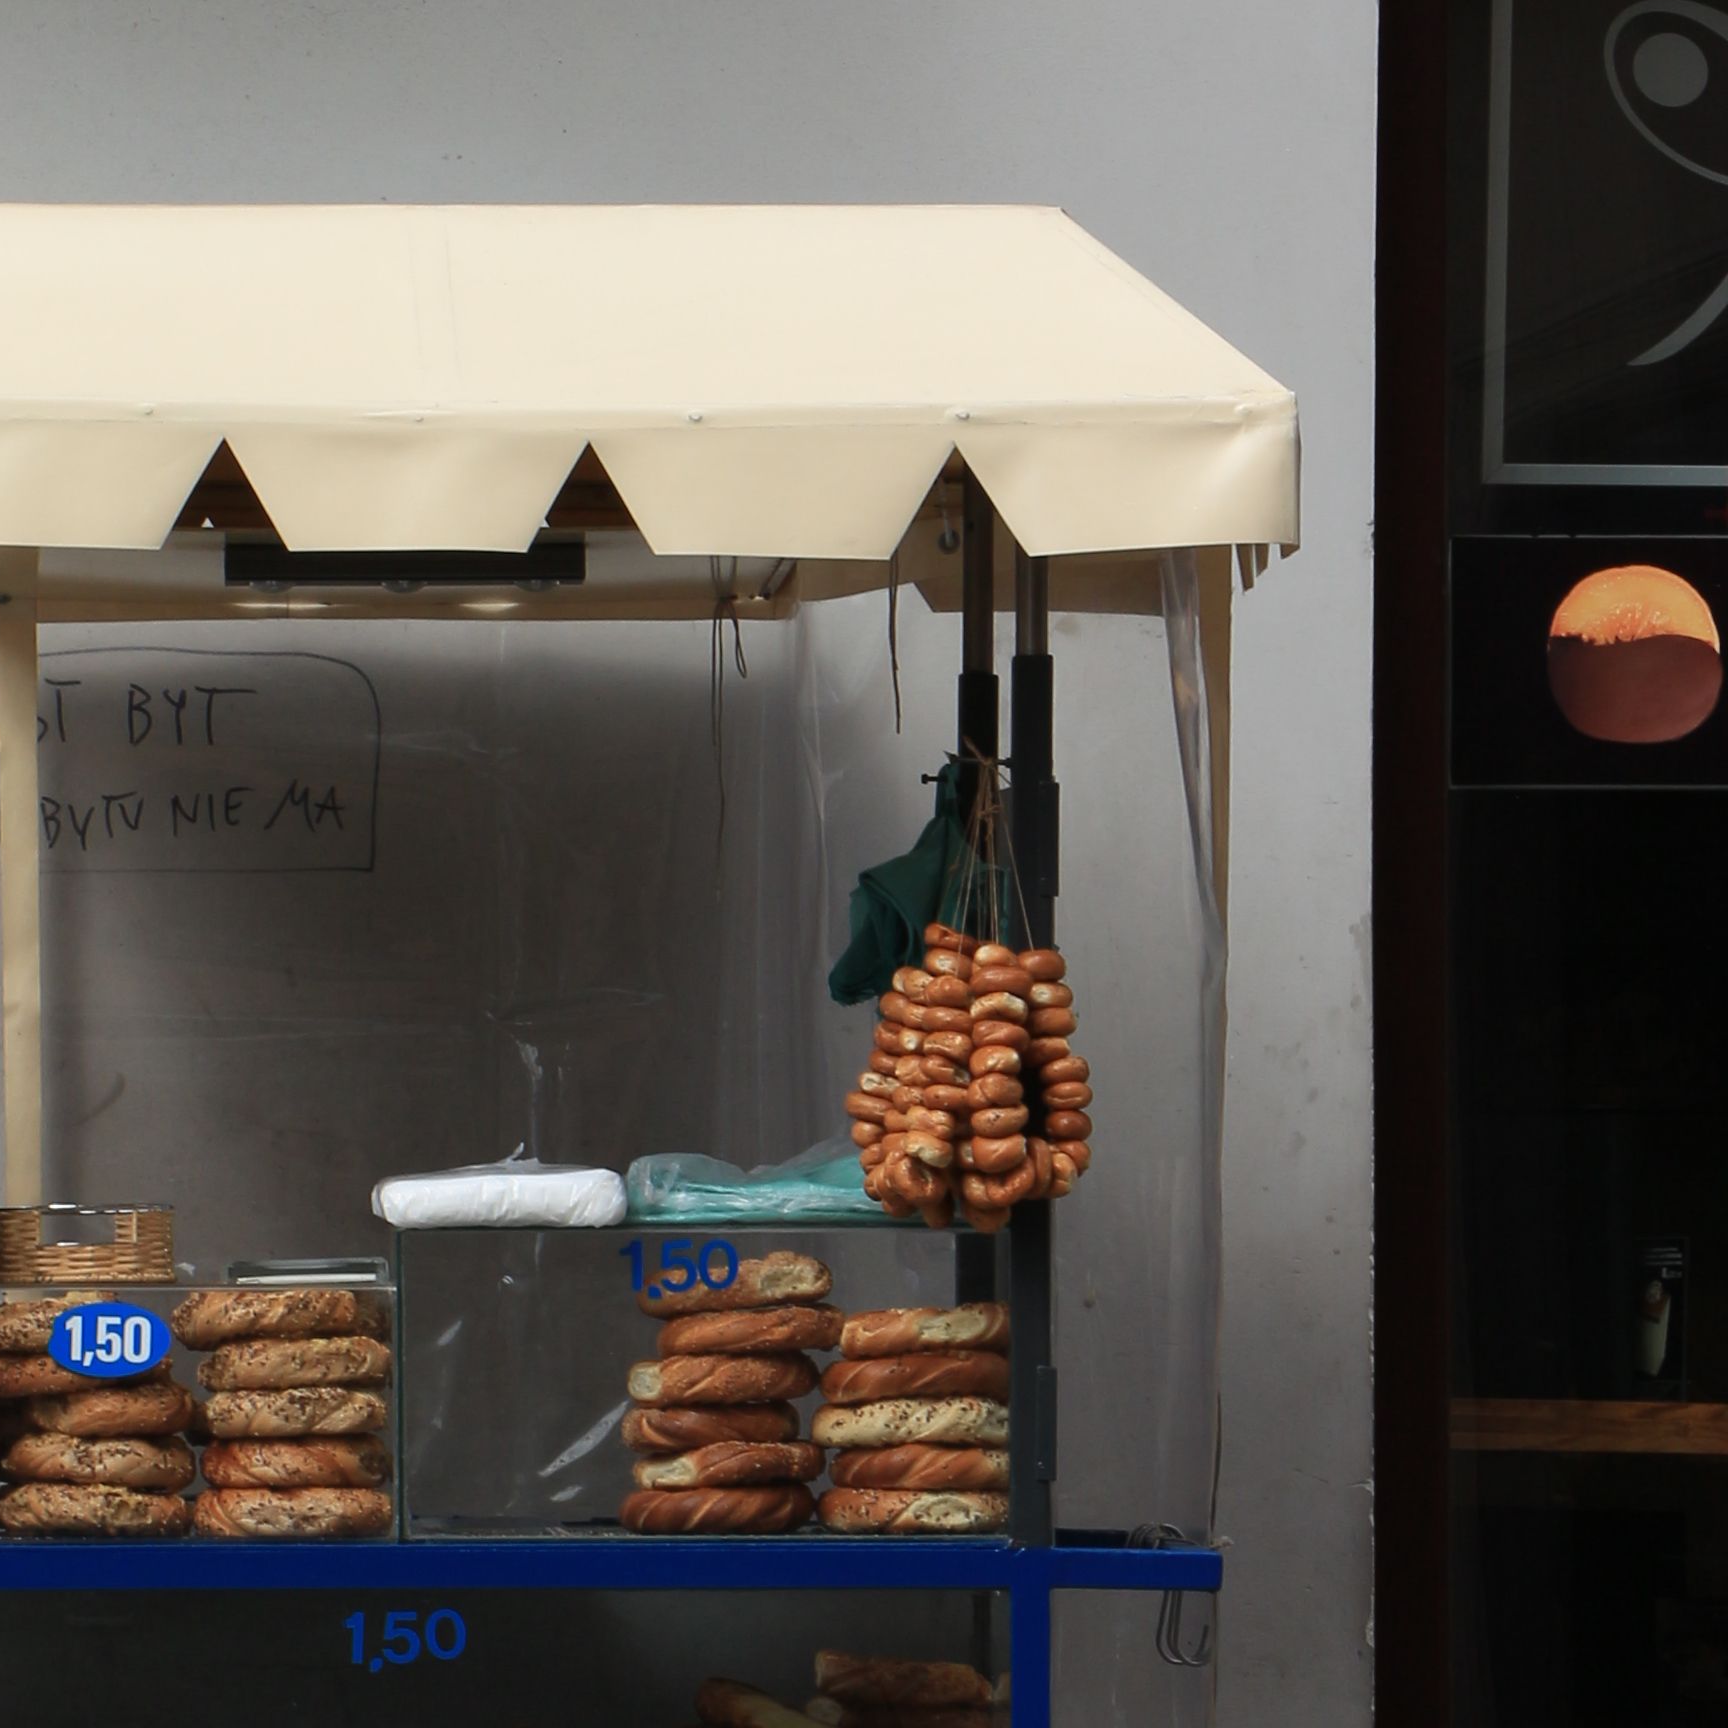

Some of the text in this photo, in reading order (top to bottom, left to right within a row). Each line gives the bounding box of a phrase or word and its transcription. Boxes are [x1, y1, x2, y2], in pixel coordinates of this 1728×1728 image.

[128, 683, 258, 747] BYT
[171, 785, 257, 837] NIE
[263, 778, 346, 833] MA
[618, 1237, 739, 1300] 1,50
[65, 1314, 152, 1367] 1,50
[343, 1608, 467, 1674] 1,50
